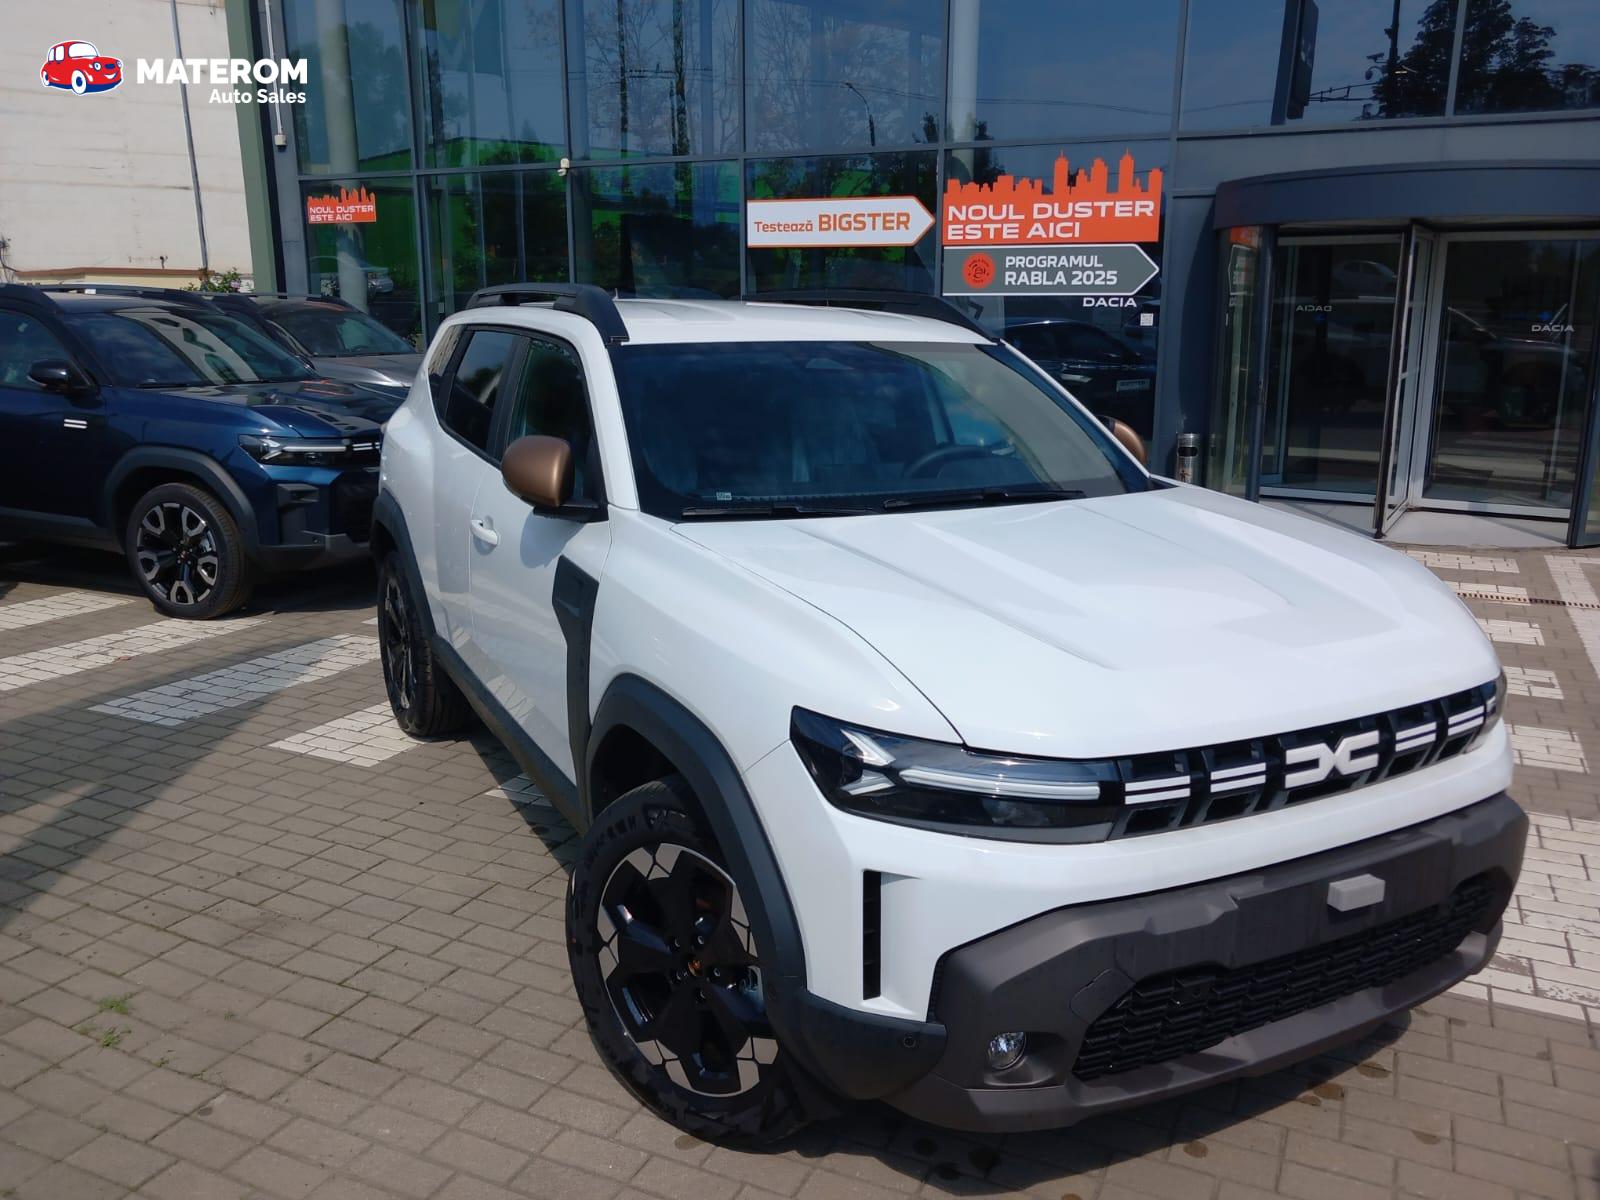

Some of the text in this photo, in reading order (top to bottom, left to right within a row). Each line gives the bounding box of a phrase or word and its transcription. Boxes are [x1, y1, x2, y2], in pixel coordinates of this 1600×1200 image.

[309, 205, 374, 214] NOUL DUSTER
[948, 200, 1154, 221] NOUL DUSTER
[336, 213, 352, 221] AICI
[754, 212, 910, 233] Testează BIGSTER
[947, 221, 1080, 240] ESTE AICI
[1005, 255, 1103, 268] PROGRAMUL
[1005, 270, 1066, 286] RABLA
[1071, 270, 1118, 286] 2025
[1083, 297, 1137, 308] DACIA
[1531, 324, 1575, 332] DACIA
